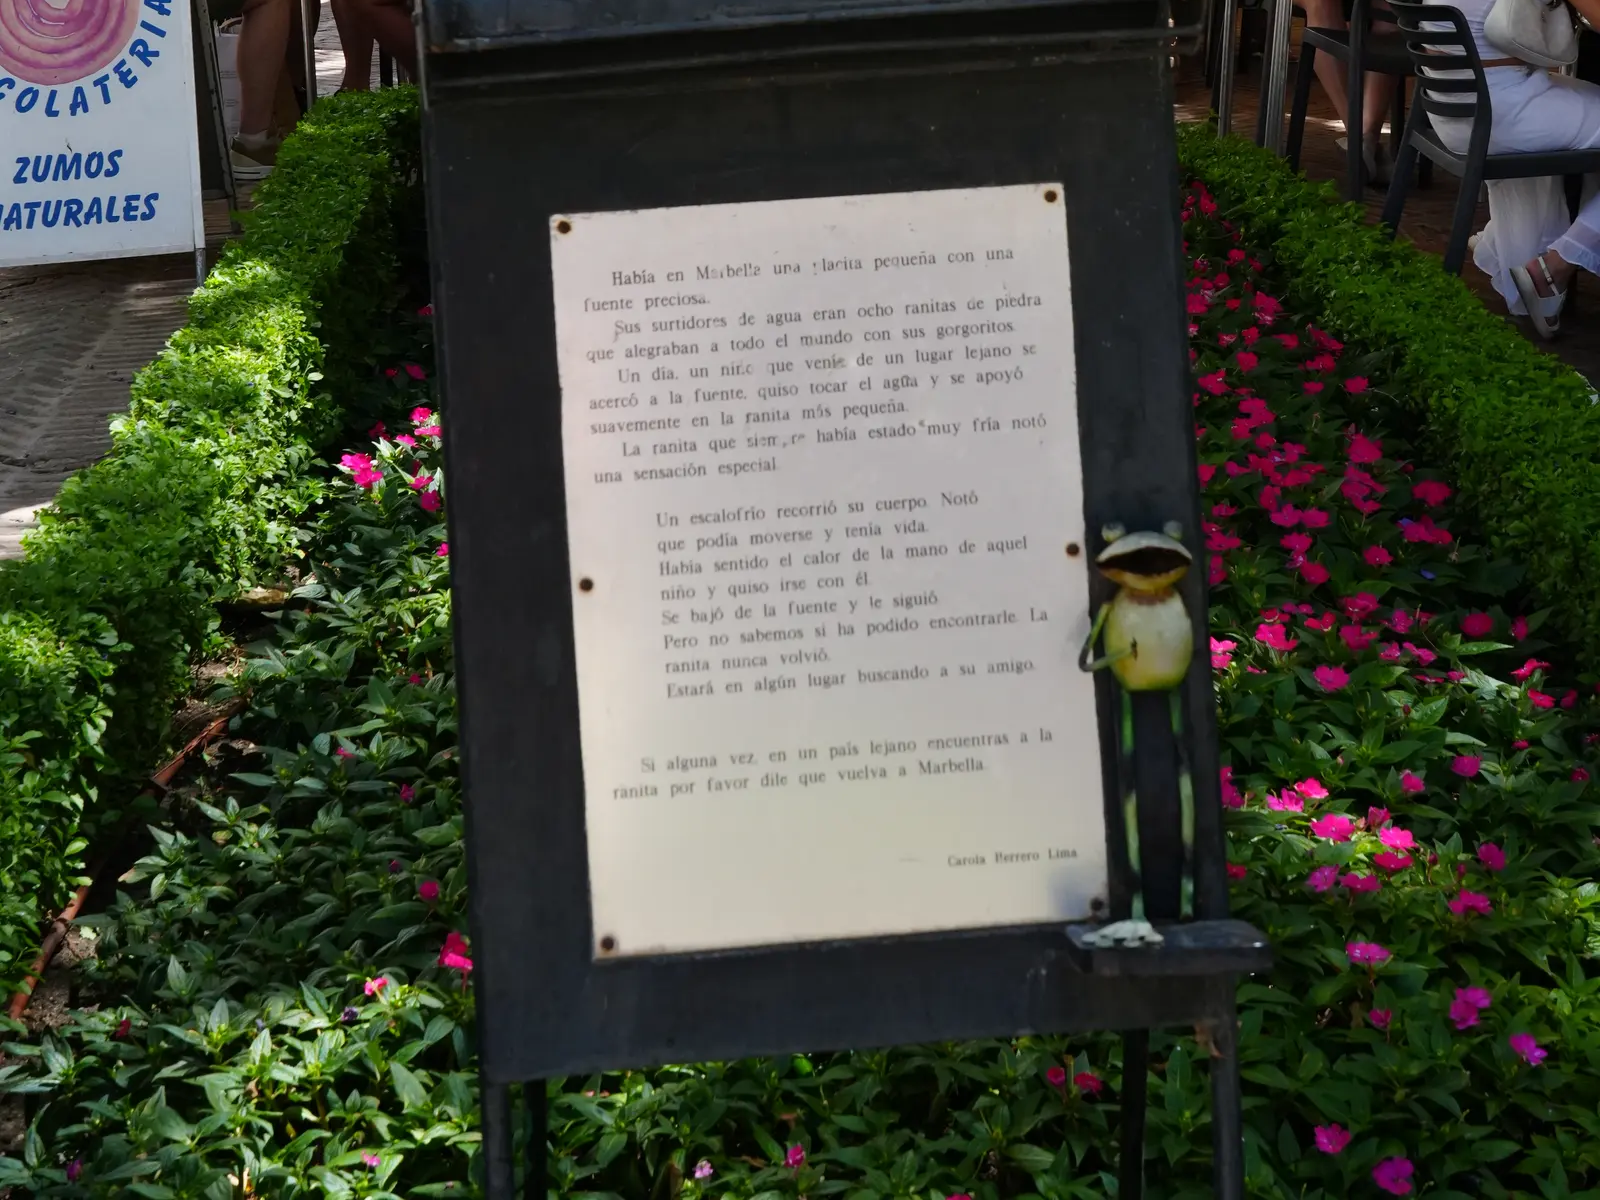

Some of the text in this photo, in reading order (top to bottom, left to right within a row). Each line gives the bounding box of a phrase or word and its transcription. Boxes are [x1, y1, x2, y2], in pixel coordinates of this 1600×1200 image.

[13, 149, 124, 184] ZUMOS
[0, 192, 160, 231] ATURALES
[611, 268, 656, 286] Había
[666, 270, 684, 282] en
[773, 262, 801, 275] una
[947, 251, 975, 264] con
[985, 248, 1014, 261] una
[583, 297, 633, 312] fuente
[651, 292, 1042, 332] surtidores de agua eran ocho ranitas de piedra
[585, 327, 926, 364] que alegraban a todo el mundo con sus
[617, 368, 641, 383] Un
[689, 367, 709, 378] un
[855, 351, 874, 367] de
[884, 353, 904, 365] un
[915, 348, 954, 365] lugar
[964, 345, 1012, 362] lejano
[1022, 344, 1036, 356] se
[589, 365, 1023, 410] acercó a la quiso tocar el y se apoyó
[589, 417, 681, 435] suavemente
[691, 415, 709, 428] en
[720, 411, 735, 426] la
[744, 409, 790, 425] ranita
[622, 412, 1047, 457] La ranita que había estado muy fría notó
[593, 462, 707, 484] una sensación
[655, 489, 979, 528] Un escalofrío recorrió su Notó
[657, 539, 685, 555] que
[696, 532, 738, 553] podía
[749, 529, 813, 546] moverse
[823, 528, 833, 543] y
[844, 521, 882, 538] tenía
[713, 554, 769, 572] sentido
[779, 551, 792, 568] el
[803, 549, 841, 566] calor
[851, 547, 869, 562] de
[880, 544, 894, 560] la
[905, 544, 948, 559] mano
[958, 539, 976, 554] de
[986, 535, 1027, 555] aquel
[659, 576, 845, 601] niño y quiso irse con
[661, 595, 882, 625] Se bajó de la fuente y le
[663, 607, 1048, 650] Pero no sabemos si ha podido La
[664, 659, 710, 674] ranita
[721, 655, 768, 670] nunca
[666, 664, 976, 699] Estará en algún lugar buscando a su
[666, 755, 717, 773] alguna
[768, 750, 787, 762] en
[798, 748, 817, 760] un
[828, 741, 859, 761] país
[869, 740, 917, 757] lejano
[1019, 732, 1028, 744] a
[1039, 727, 1053, 743] la
[612, 764, 907, 800] ranita por favor dile que vuelva a
